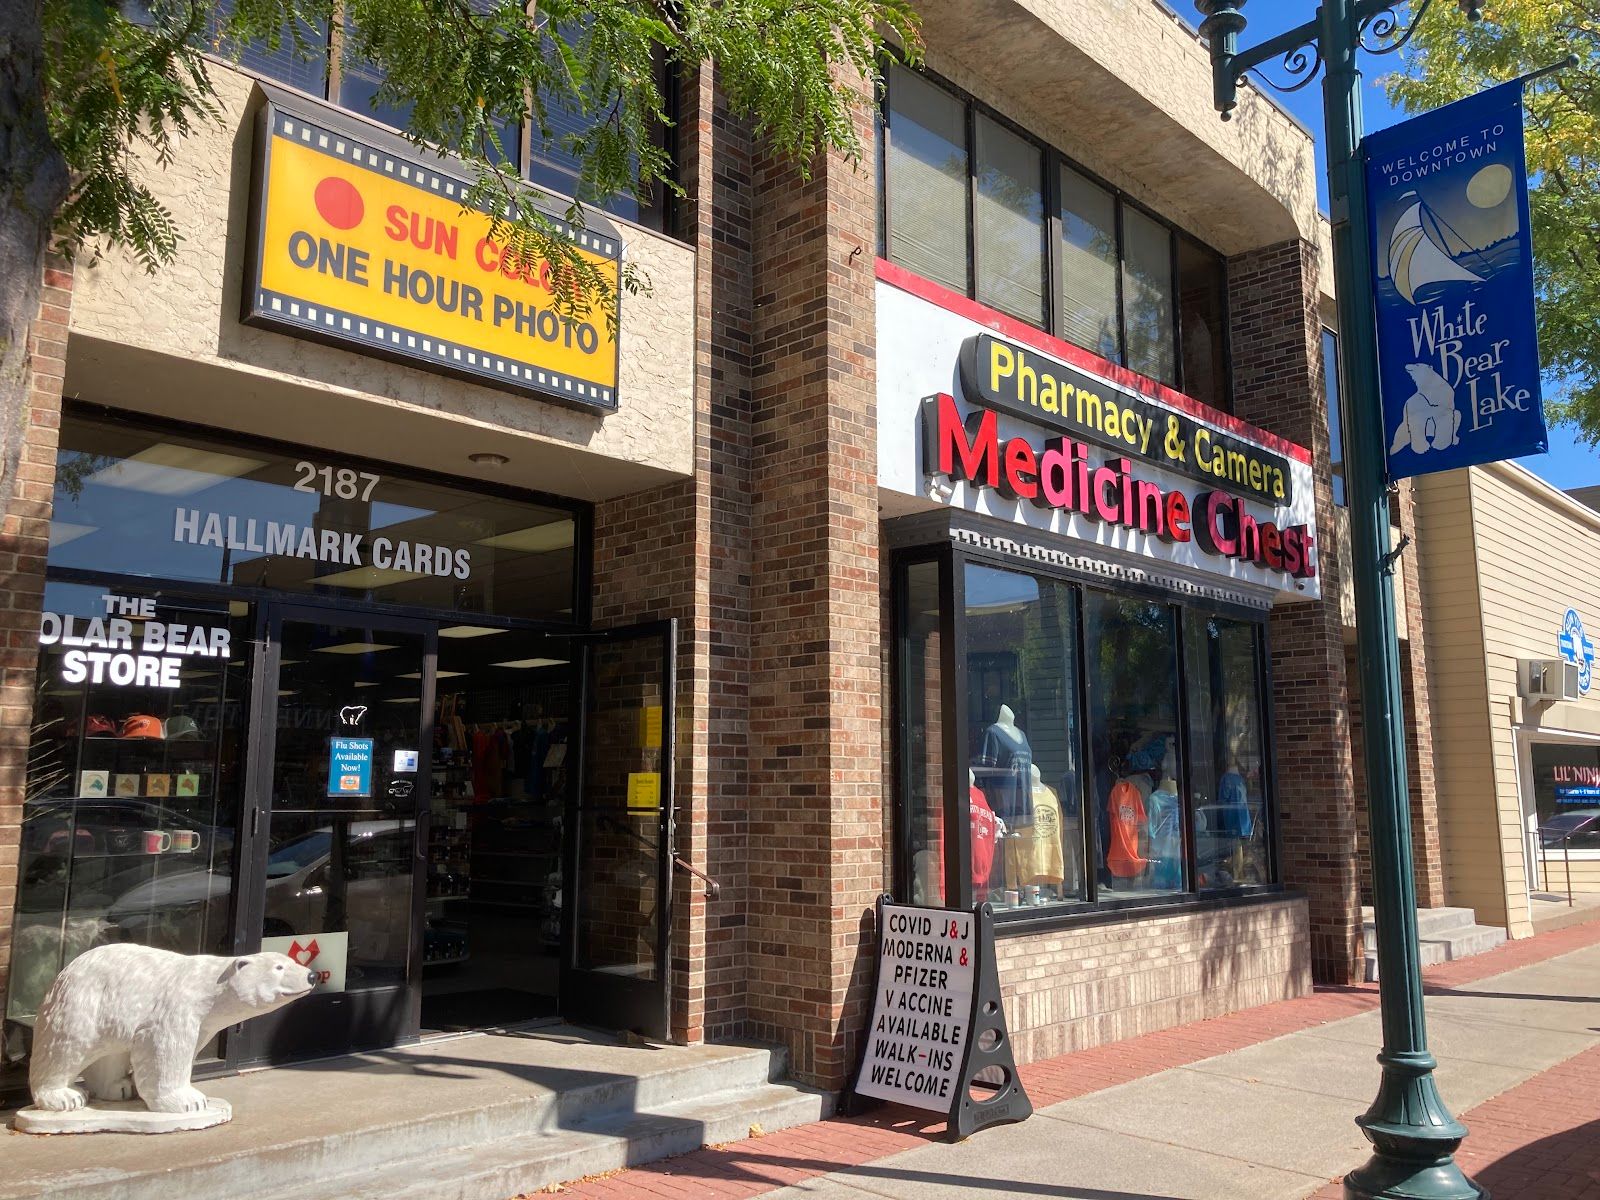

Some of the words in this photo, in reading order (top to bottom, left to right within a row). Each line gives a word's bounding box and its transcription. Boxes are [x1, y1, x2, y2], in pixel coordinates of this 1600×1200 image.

[1381, 135, 1470, 175] WELCOME
[1480, 124, 1505, 145] TO
[1390, 141, 1497, 186] DOWNTOWN
[384, 205, 458, 260] SUN
[288, 230, 370, 288] ONE
[384, 259, 483, 322] HOUR
[493, 294, 599, 355] PHOTO
[1407, 300, 1488, 358] White
[1435, 339, 1510, 389] Bear
[990, 341, 1153, 455] Pharmacy
[1164, 415, 1186, 462] &
[1194, 428, 1286, 499] Camera
[1465, 372, 1531, 433] Lake
[293, 461, 380, 503] 2187
[935, 392, 1191, 543] Medicine
[1205, 490, 1316, 578] Chest
[174, 507, 364, 566] HALLMARK
[372, 537, 471, 580] CARDS
[102, 595, 157, 618] THE
[39, 612, 133, 650] OLAR
[142, 621, 231, 658] BEAR
[62, 650, 182, 688] STORE
[335, 741, 348, 750] Flu
[349, 741, 369, 751] Shots
[335, 752, 369, 761] Available
[340, 763, 361, 772] Now!
[889, 914, 932, 936] COVID
[940, 919, 969, 940] J&J
[882, 938, 953, 965] MODERNA
[959, 947, 969, 967] &
[894, 965, 948, 990] PFIZER
[876, 1014, 961, 1045] AVAILABLE
[875, 1039, 954, 1072] WALK-INS
[871, 1064, 950, 1098] WELCOME
